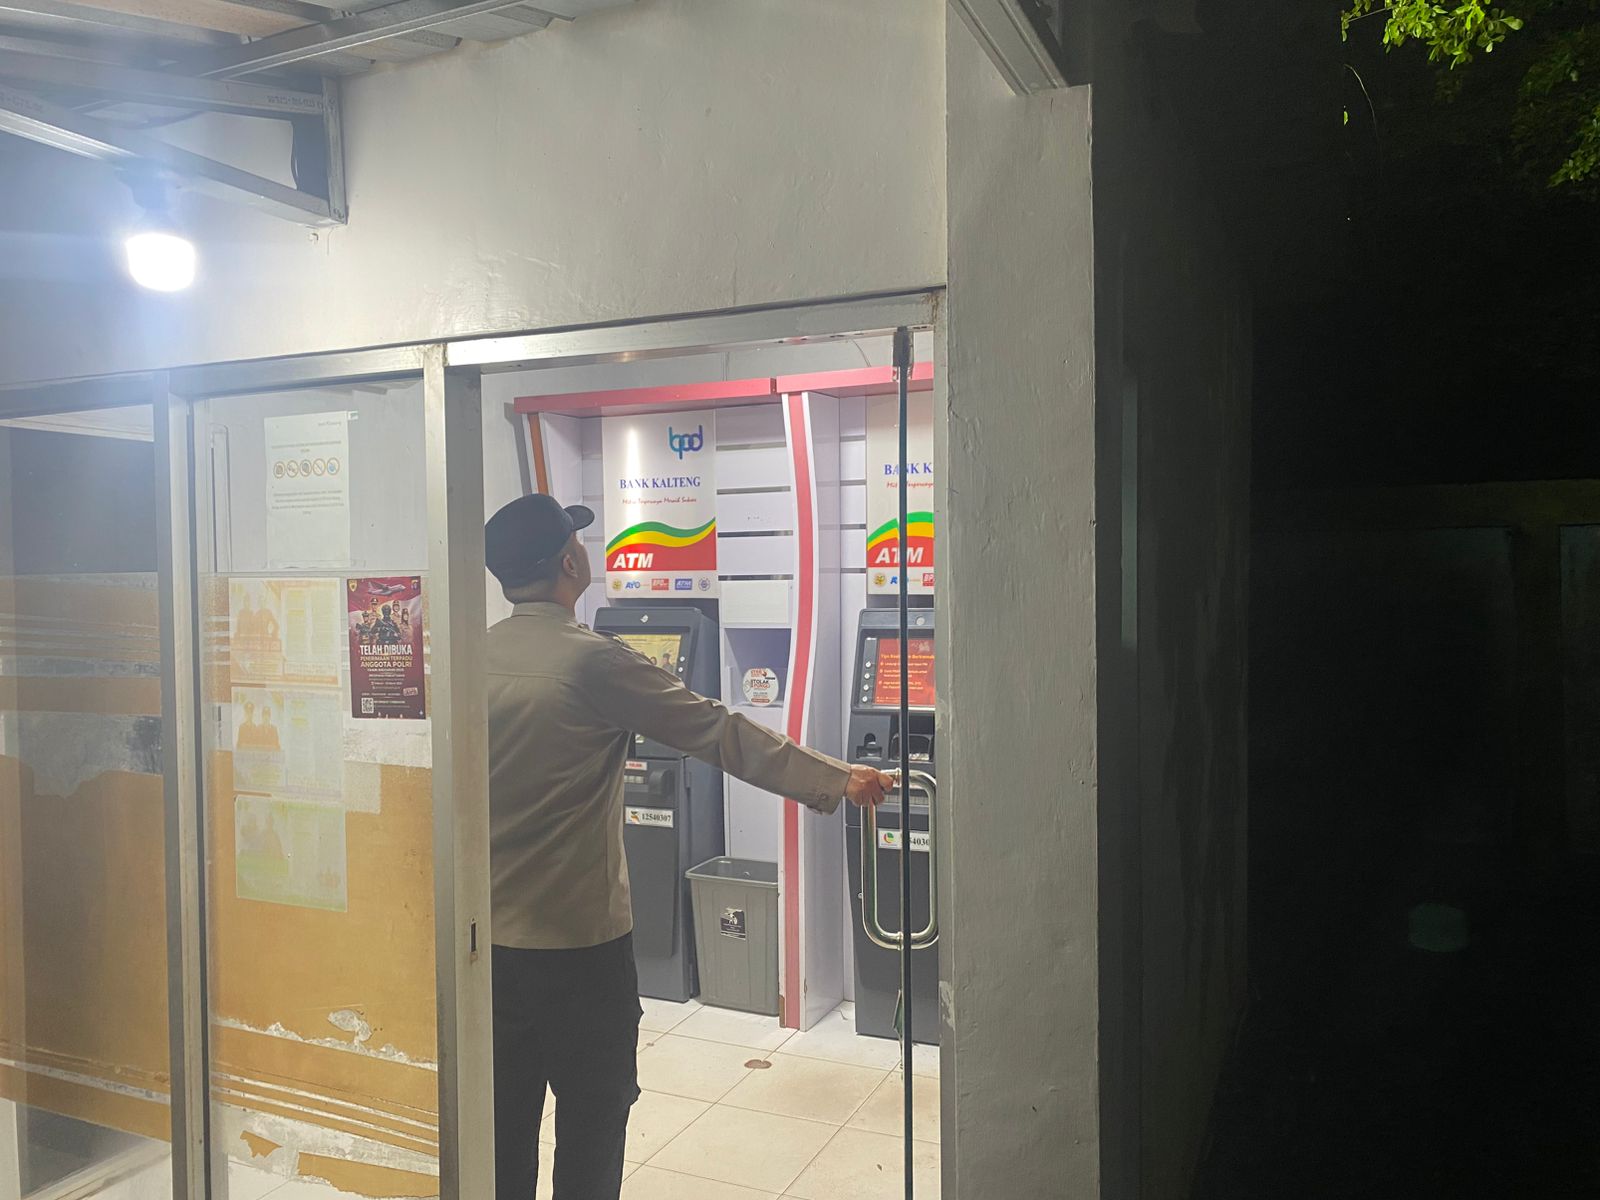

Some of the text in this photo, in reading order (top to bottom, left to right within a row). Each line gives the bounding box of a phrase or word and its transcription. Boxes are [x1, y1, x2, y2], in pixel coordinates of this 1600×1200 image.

[884, 462, 920, 475] BAK
[619, 476, 701, 489] BANK KALTENG
[613, 553, 654, 569] ATM
[360, 645, 413, 655] TELAH DIBUKA
